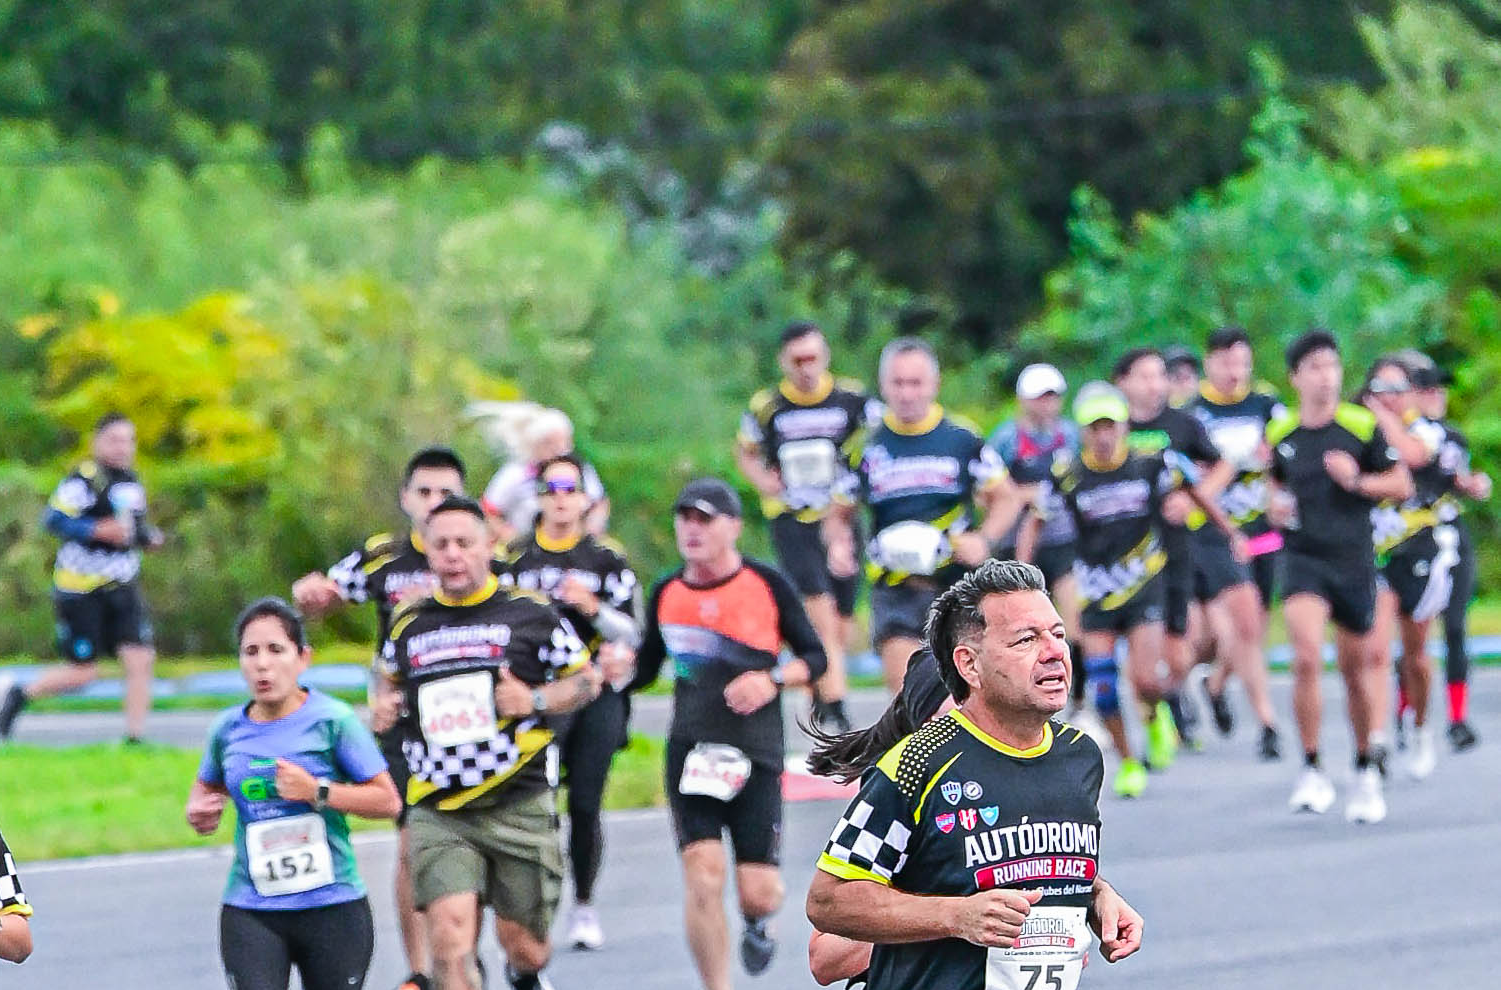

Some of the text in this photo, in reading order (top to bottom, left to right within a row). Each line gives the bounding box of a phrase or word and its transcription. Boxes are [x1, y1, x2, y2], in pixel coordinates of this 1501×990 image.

[964, 815, 1098, 868] AUTÓDROMO
[265, 852, 318, 881] 152
[992, 858, 1088, 886] RUNNING RACE
[1019, 913, 1071, 936] UTÓDRO
